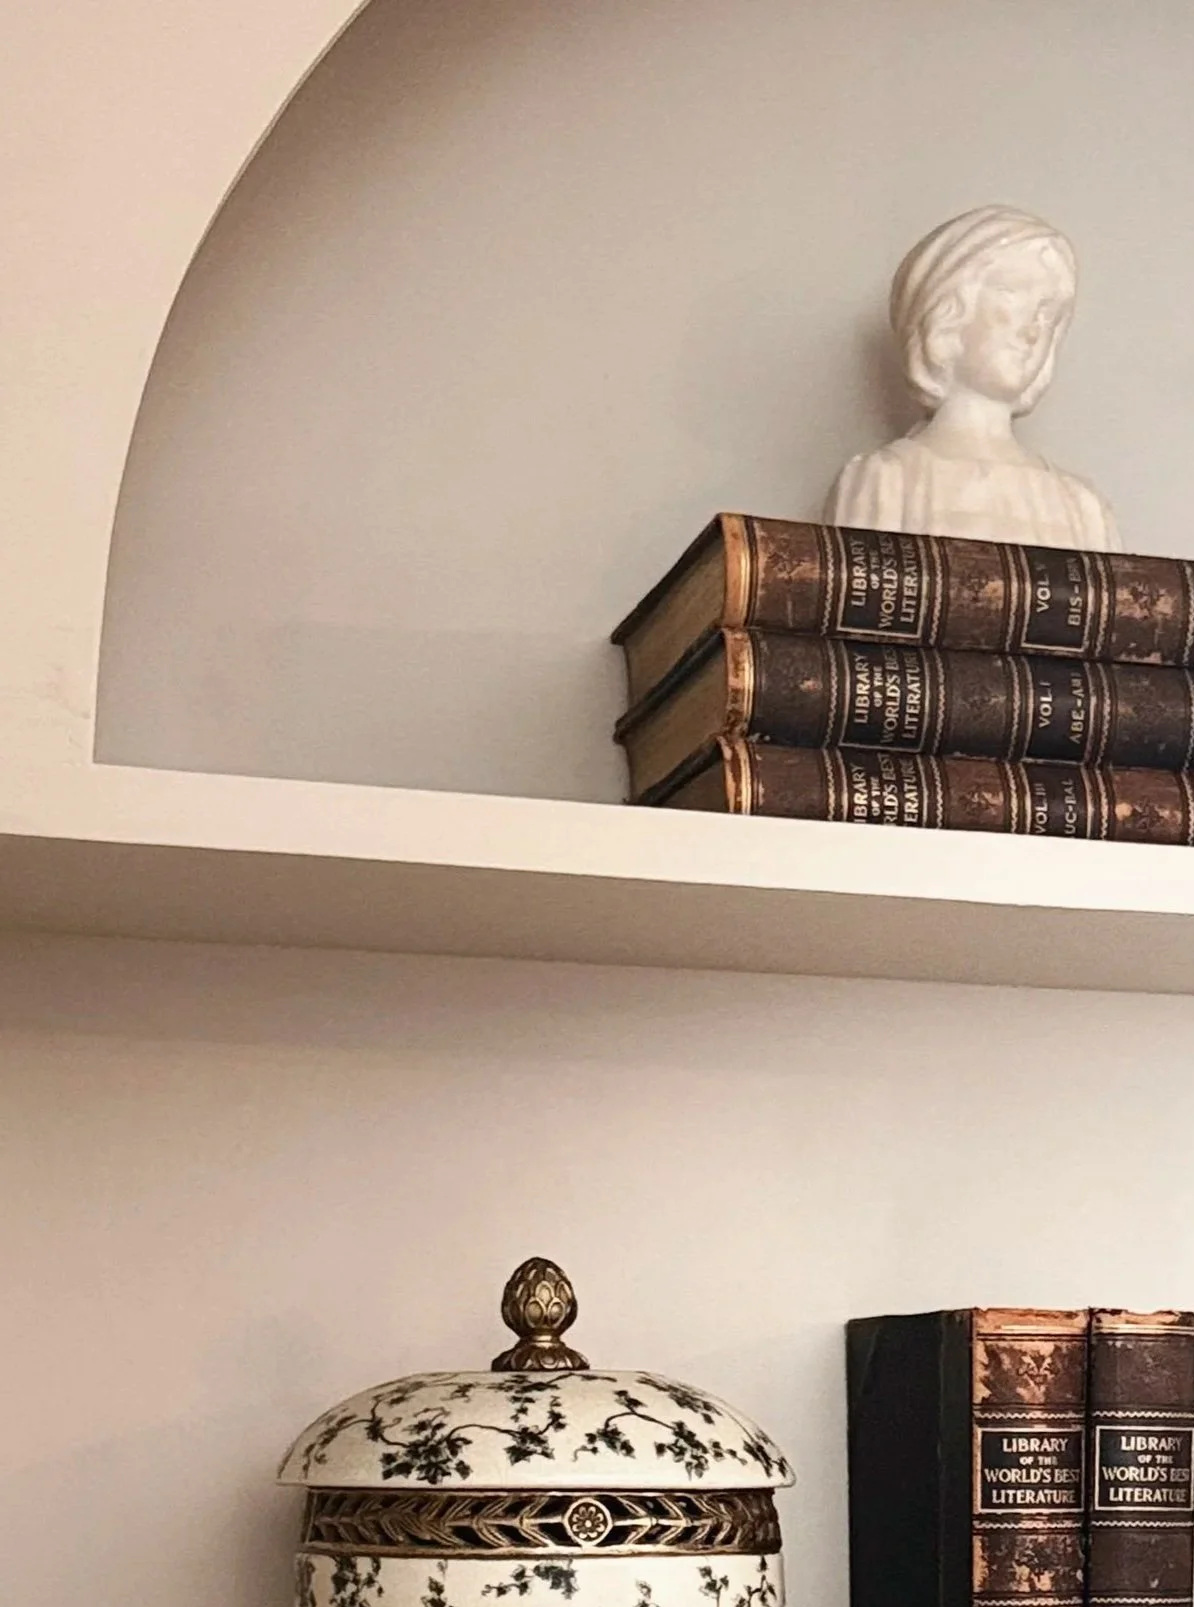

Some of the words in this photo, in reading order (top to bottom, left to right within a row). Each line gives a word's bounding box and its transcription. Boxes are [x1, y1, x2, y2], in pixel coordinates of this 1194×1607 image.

[869, 550, 880, 570] THE
[850, 536, 867, 606] LIBRARY
[870, 573, 880, 589] OF
[878, 559, 898, 628] WORLD'S
[873, 666, 883, 687] THE
[854, 652, 870, 724] LIBRARY
[873, 691, 883, 707] OF
[880, 674, 901, 743] WORLD'S
[877, 752, 896, 780] BEST
[850, 762, 868, 823] IBRARY
[900, 758, 918, 825] ERATURE
[871, 800, 880, 816] OF
[883, 784, 899, 826] RLD'S
[1061, 779, 1077, 835] UC-BAL
[1002, 1438, 1068, 1453] LIBRARY
[1120, 1436, 1183, 1452] LIBRARY
[1019, 1456, 1034, 1465] OF
[1038, 1456, 1058, 1465] THE
[1137, 1454, 1152, 1464] OF
[1155, 1454, 1173, 1464] THE
[984, 1468, 1052, 1483] WORLD'S
[1054, 1468, 1081, 1484] BEST
[1102, 1466, 1168, 1482] WORLD'S
[1170, 1468, 1190, 1482] BEST
[992, 1489, 1076, 1504] LITERATURE
[1109, 1487, 1187, 1503] LITERATURE
